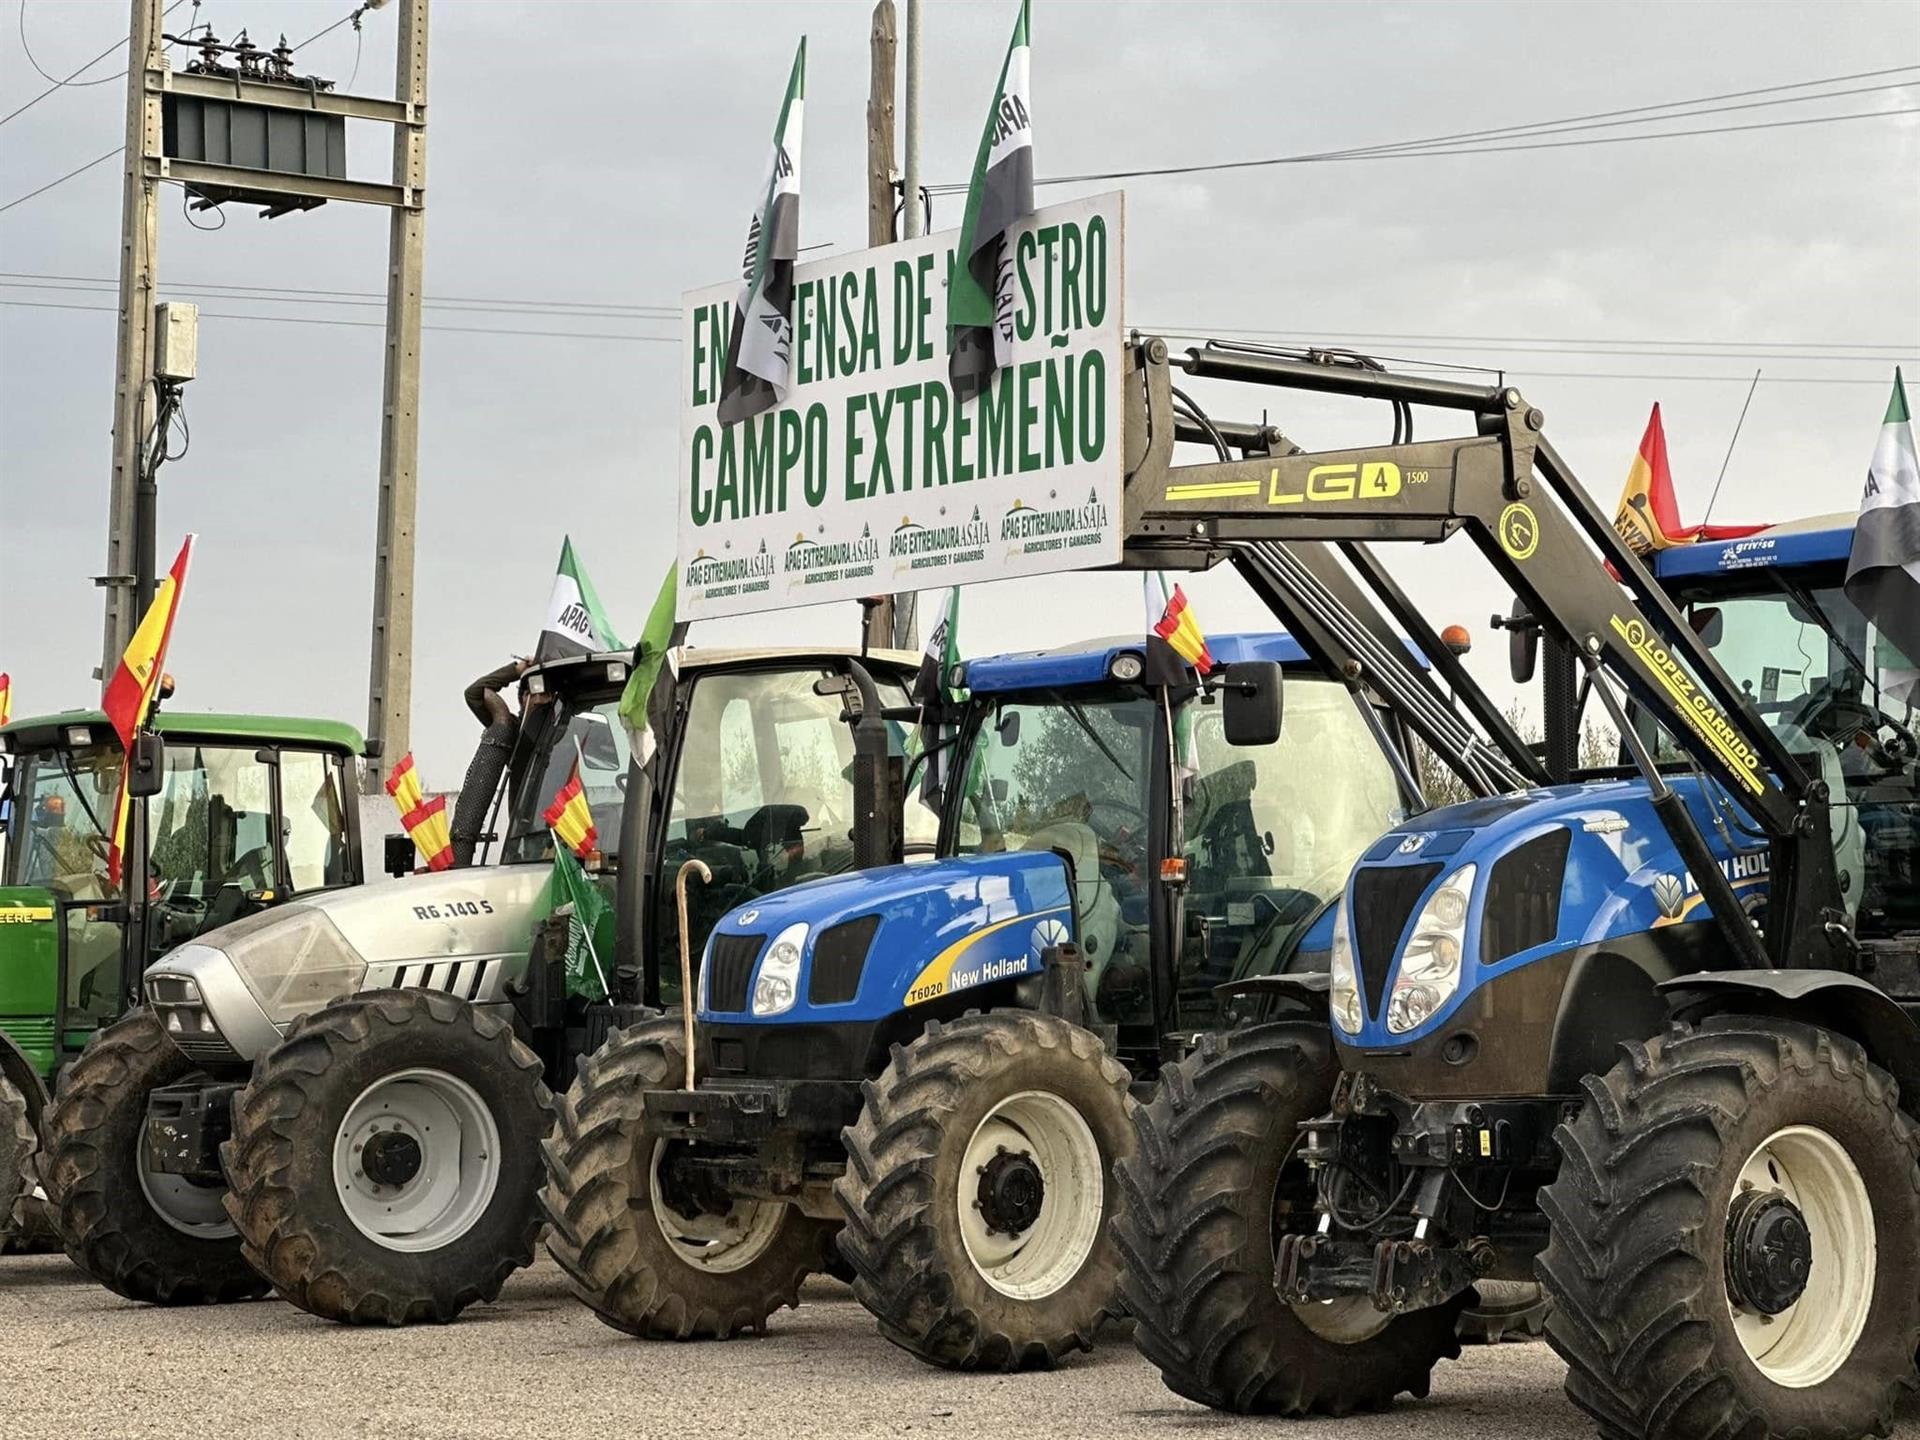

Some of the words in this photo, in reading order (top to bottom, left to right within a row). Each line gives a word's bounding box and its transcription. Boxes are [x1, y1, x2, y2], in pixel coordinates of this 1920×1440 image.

[693, 301, 729, 407] EN
[793, 266, 881, 385] ENSA
[894, 253, 934, 366] DE
[691, 402, 828, 526] CAMPO
[845, 334, 1106, 502] EXTREMEÑO
[1406, 471, 1429, 484] 1500
[889, 533, 908, 557] APAG
[909, 525, 959, 554] EXTREMADURA
[960, 521, 990, 548] ASAJA
[1000, 515, 1020, 541] APAG
[1021, 508, 1076, 538] EXTREMADURA
[1076, 505, 1108, 532] ASAJA
[784, 550, 801, 572] APAG
[803, 542, 850, 569] EXTREMADURA
[851, 538, 880, 565] ASAJA
[910, 553, 948, 570] AGRICULTORES
[948, 554, 953, 565] Y
[953, 549, 985, 564] GANADEROS
[1023, 537, 1063, 554] AGRICULTORES
[1063, 538, 1068, 549] Y
[1068, 532, 1102, 548] GANADEROS
[686, 565, 703, 587] APAG
[703, 557, 749, 585] EXTREMADURA
[748, 555, 775, 579] ASAJA
[804, 569, 839, 584] AGRICULTORES
[1643, 638, 1695, 697] LOPEZ
[1692, 695, 1758, 770] GARRIDO
[951, 969, 980, 990] New
[983, 953, 1028, 981] Holland
[910, 982, 943, 1002] T6020
